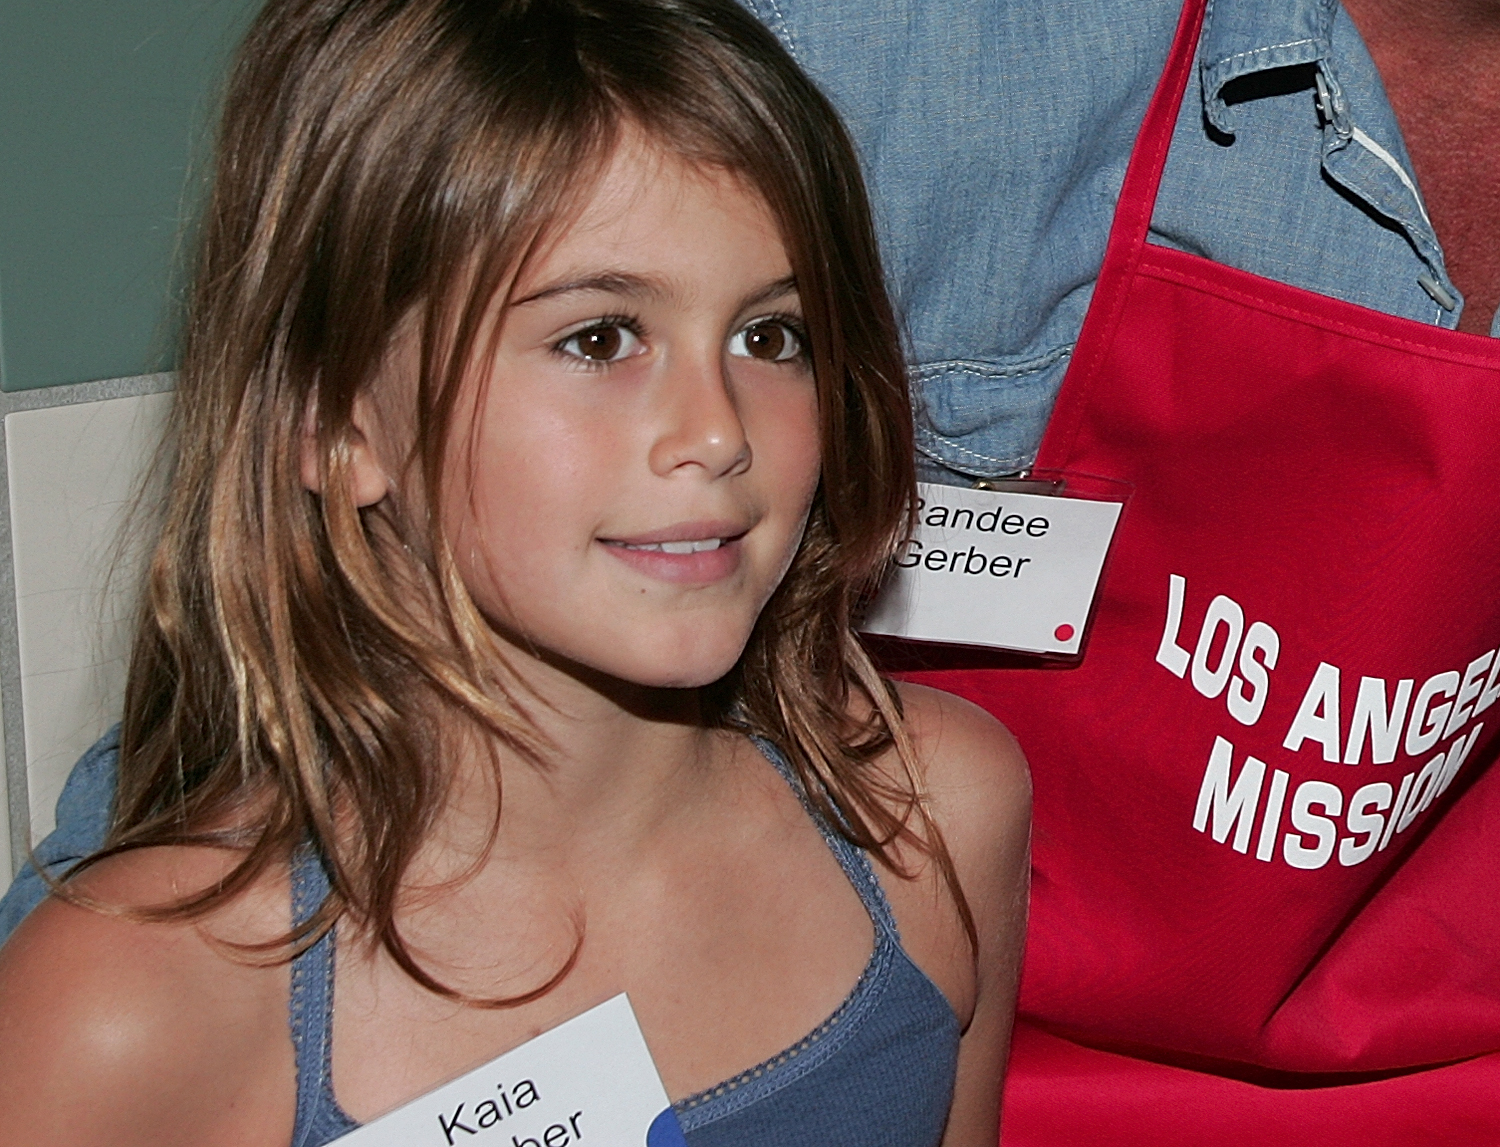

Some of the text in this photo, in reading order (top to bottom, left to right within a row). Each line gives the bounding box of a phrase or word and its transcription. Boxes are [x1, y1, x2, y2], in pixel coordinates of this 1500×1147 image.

[893, 538, 1031, 578] Gerber
[1155, 573, 1280, 726] LOS
[1192, 722, 1484, 869] MISSION
[438, 1079, 541, 1146] Kaia
